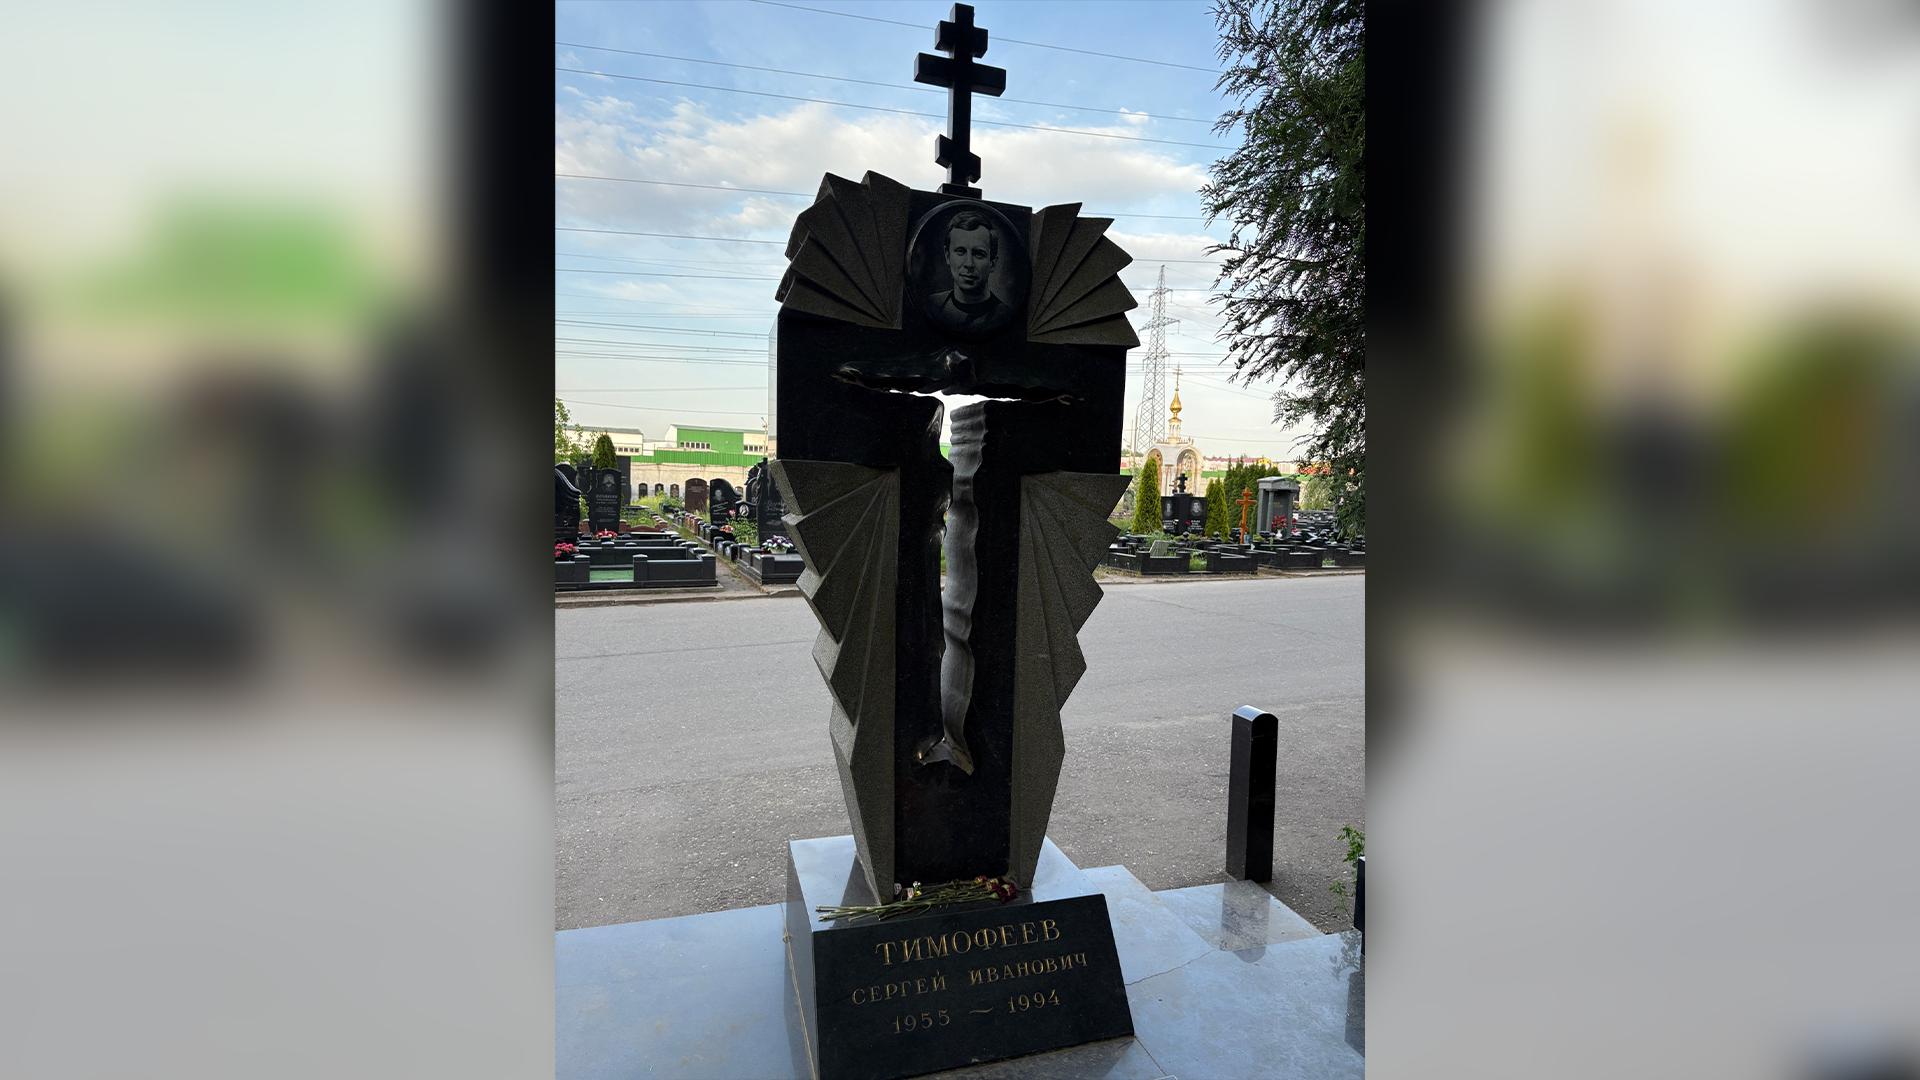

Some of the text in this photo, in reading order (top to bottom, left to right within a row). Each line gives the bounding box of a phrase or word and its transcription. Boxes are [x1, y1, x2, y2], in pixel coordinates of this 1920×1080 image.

[874, 919, 1061, 967] ТИМОФЕЕВ
[851, 952, 1088, 1006] СЕРГЕЙ ИВАНОВИЧ
[892, 1009, 950, 1034] 1955
[1008, 988, 1061, 1014] 1994
